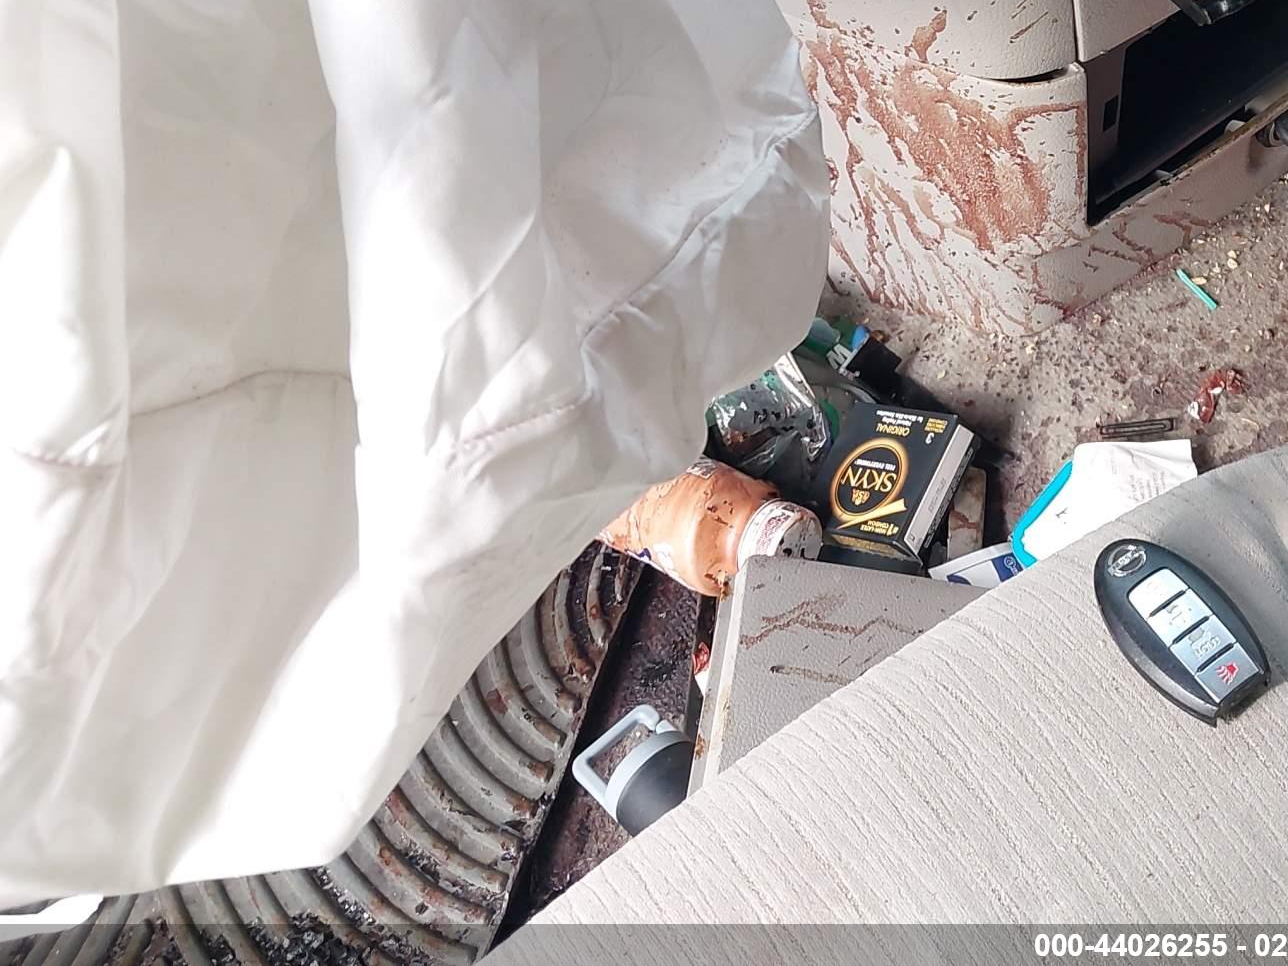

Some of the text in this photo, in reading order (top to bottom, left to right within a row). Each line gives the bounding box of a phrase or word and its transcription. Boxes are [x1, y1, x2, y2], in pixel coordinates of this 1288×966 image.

[876, 423, 910, 437] ORIGINAL
[925, 432, 935, 445] 3
[841, 466, 897, 493] SKYN
